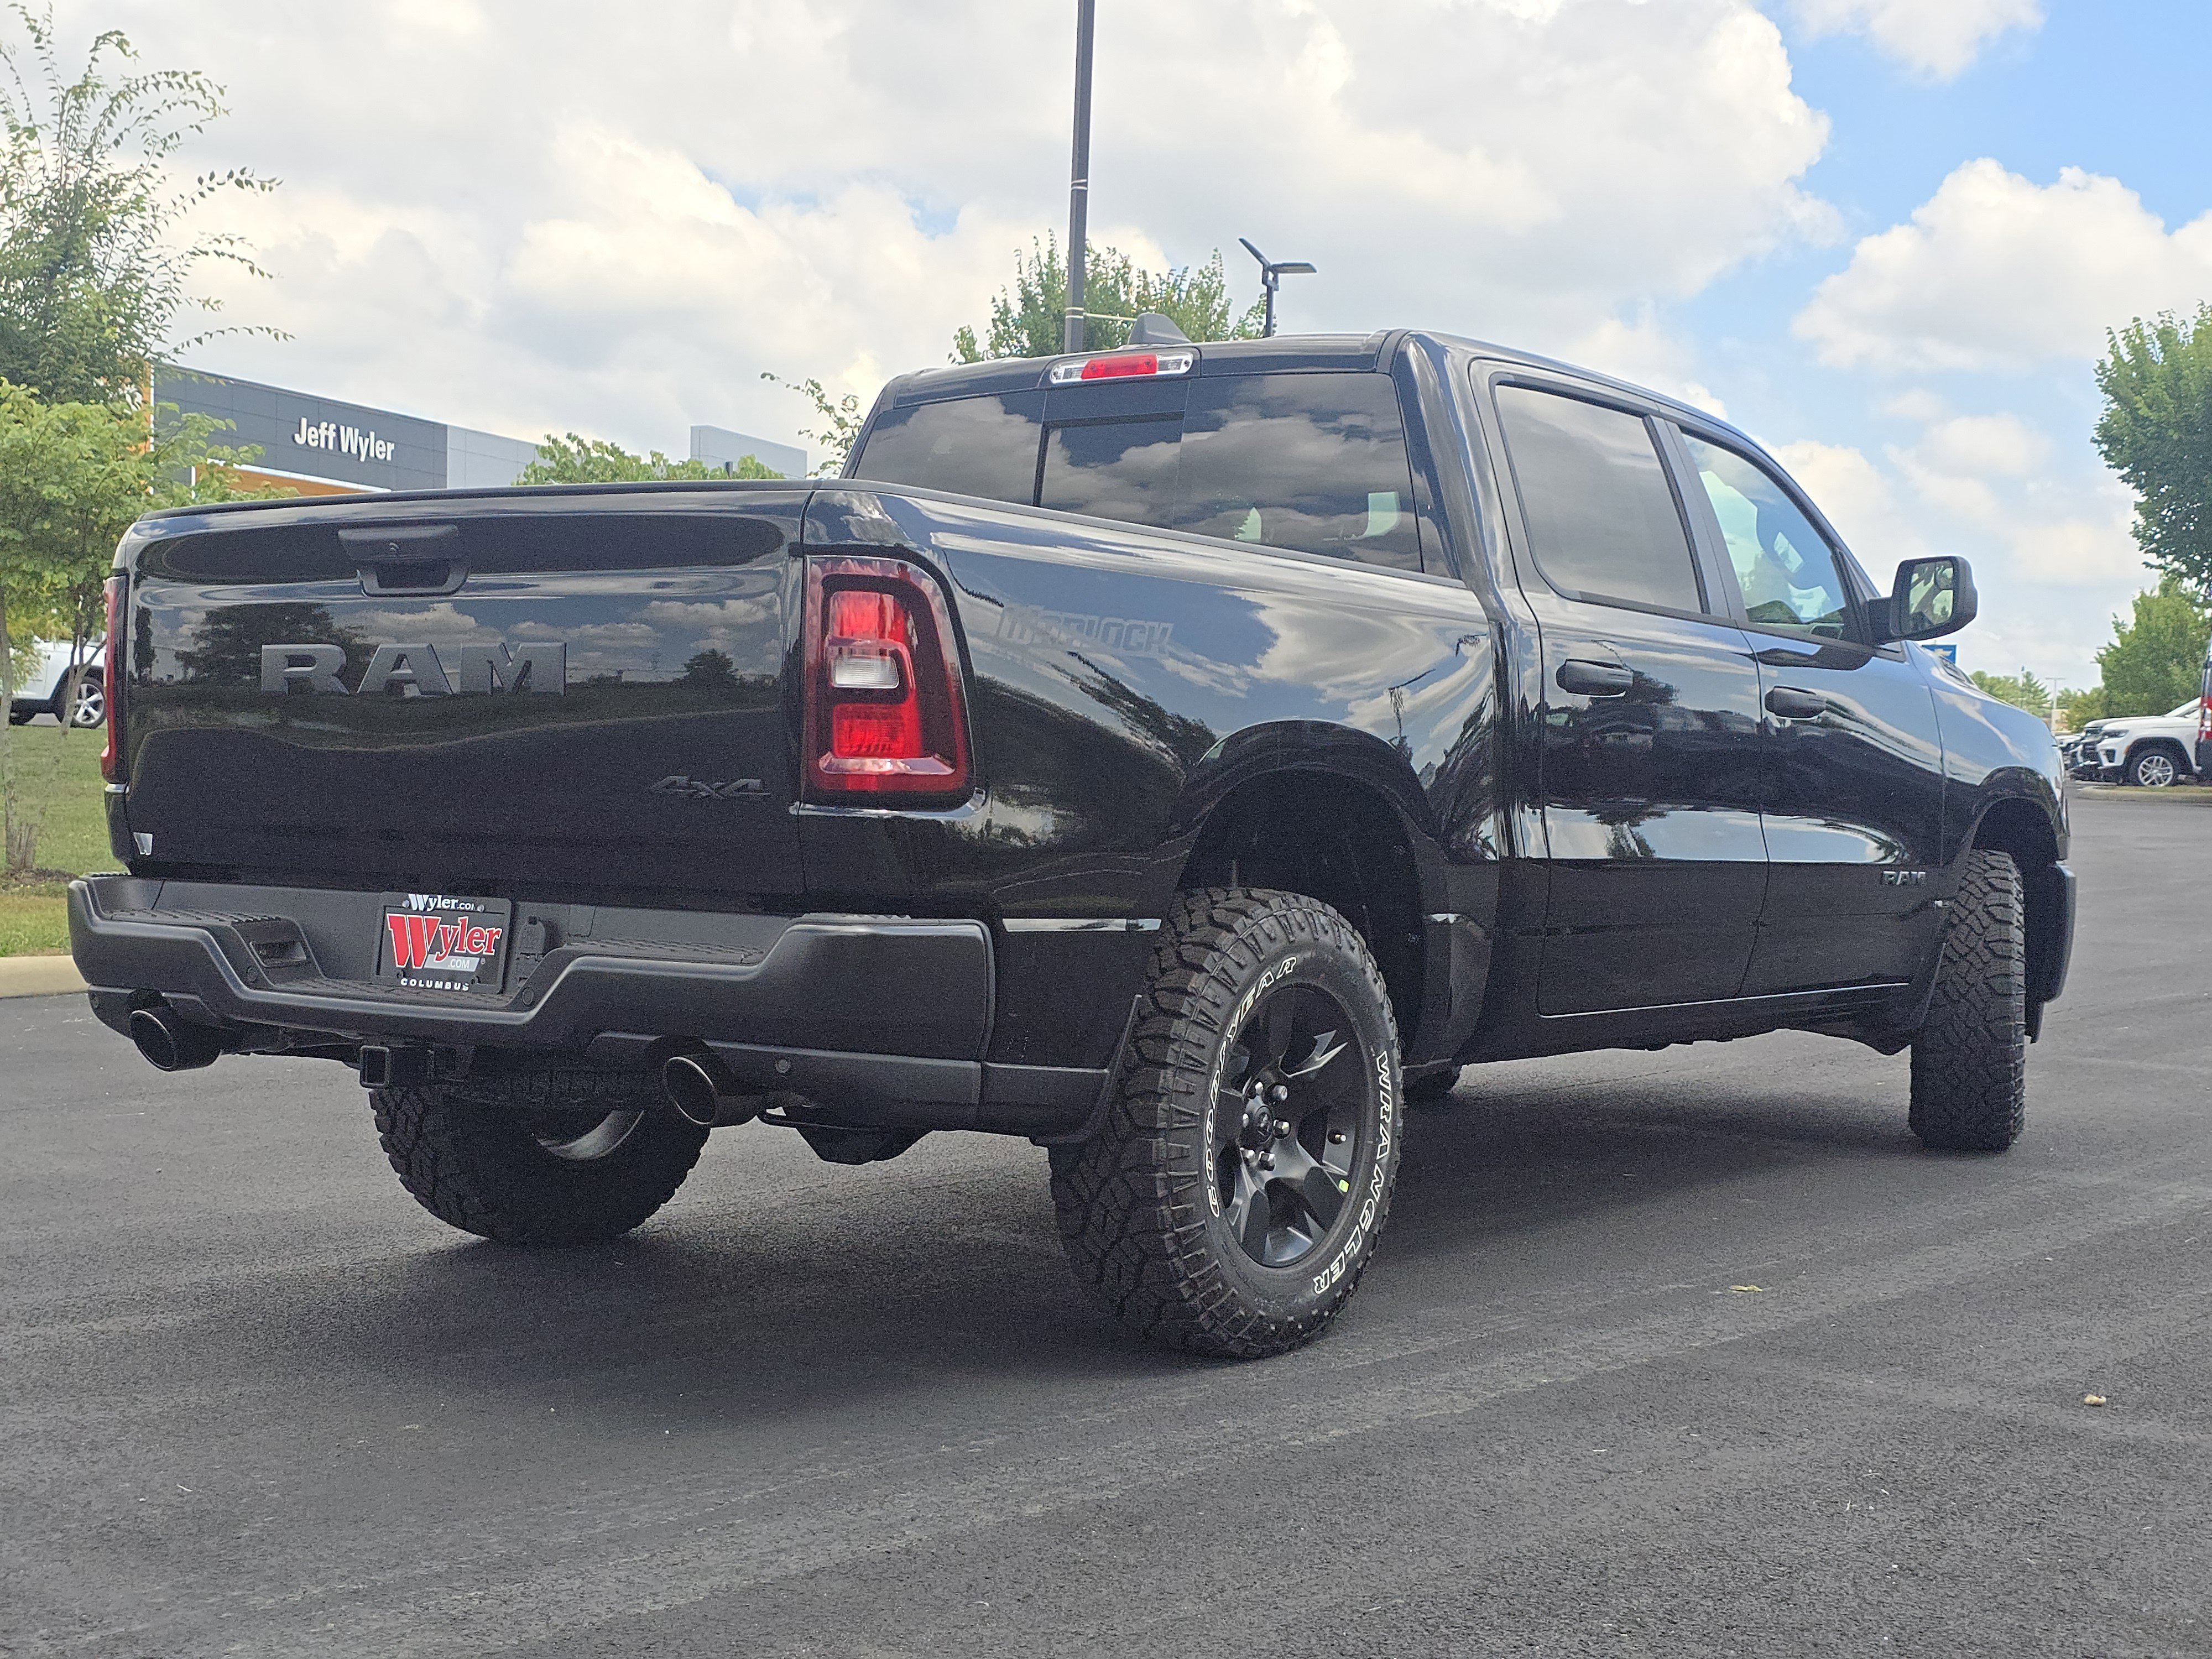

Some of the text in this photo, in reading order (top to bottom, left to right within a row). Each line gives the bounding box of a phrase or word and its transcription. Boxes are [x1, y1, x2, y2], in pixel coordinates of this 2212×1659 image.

[294, 417, 395, 462] Jeff Wyler
[261, 641, 567, 696] RAM
[387, 913, 503, 969] Wyler
[447, 958, 470, 969] .COM
[400, 978, 469, 991] COLUMBUS
[1205, 956, 1297, 1218] GOODYEAR
[1312, 1050, 1391, 1295] WRANGLER
